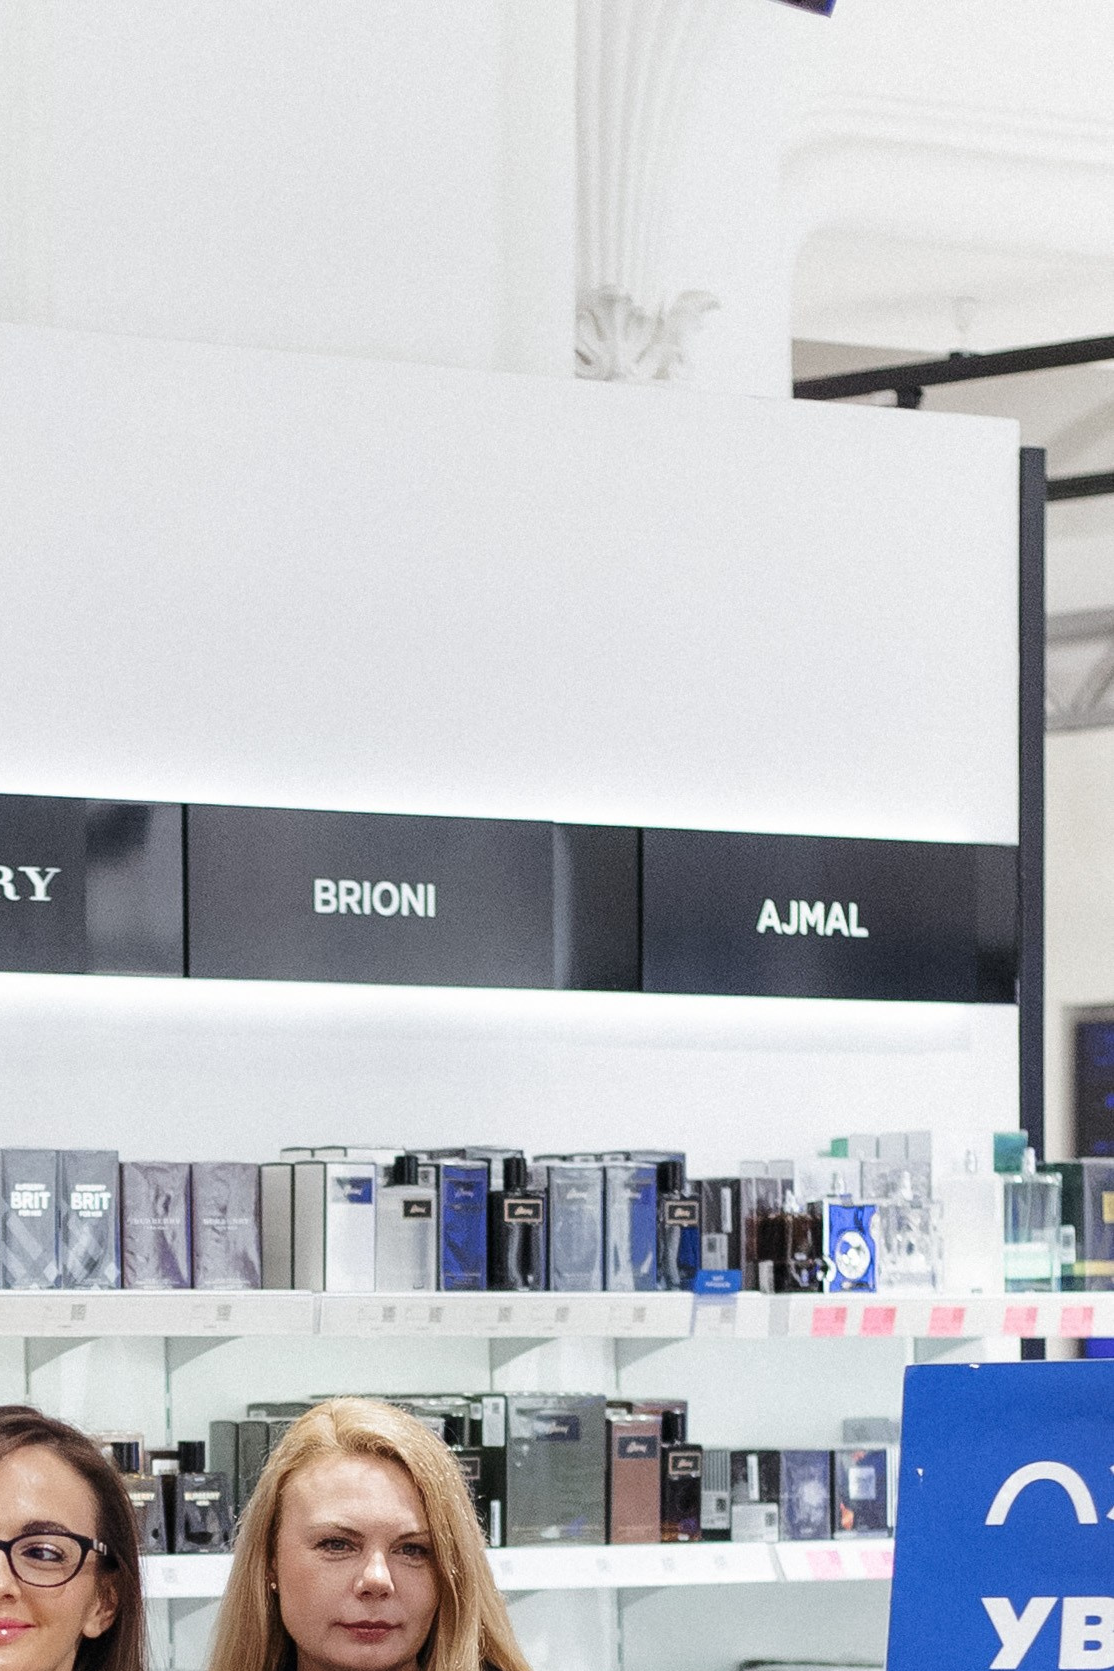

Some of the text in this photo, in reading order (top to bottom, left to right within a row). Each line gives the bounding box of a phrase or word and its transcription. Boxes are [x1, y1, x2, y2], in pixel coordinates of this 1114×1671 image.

[313, 877, 437, 919] BRIONI
[755, 898, 870, 938] AJMAL
[10, 1190, 52, 1210] BRIT
[70, 1191, 112, 1211] BRIT
